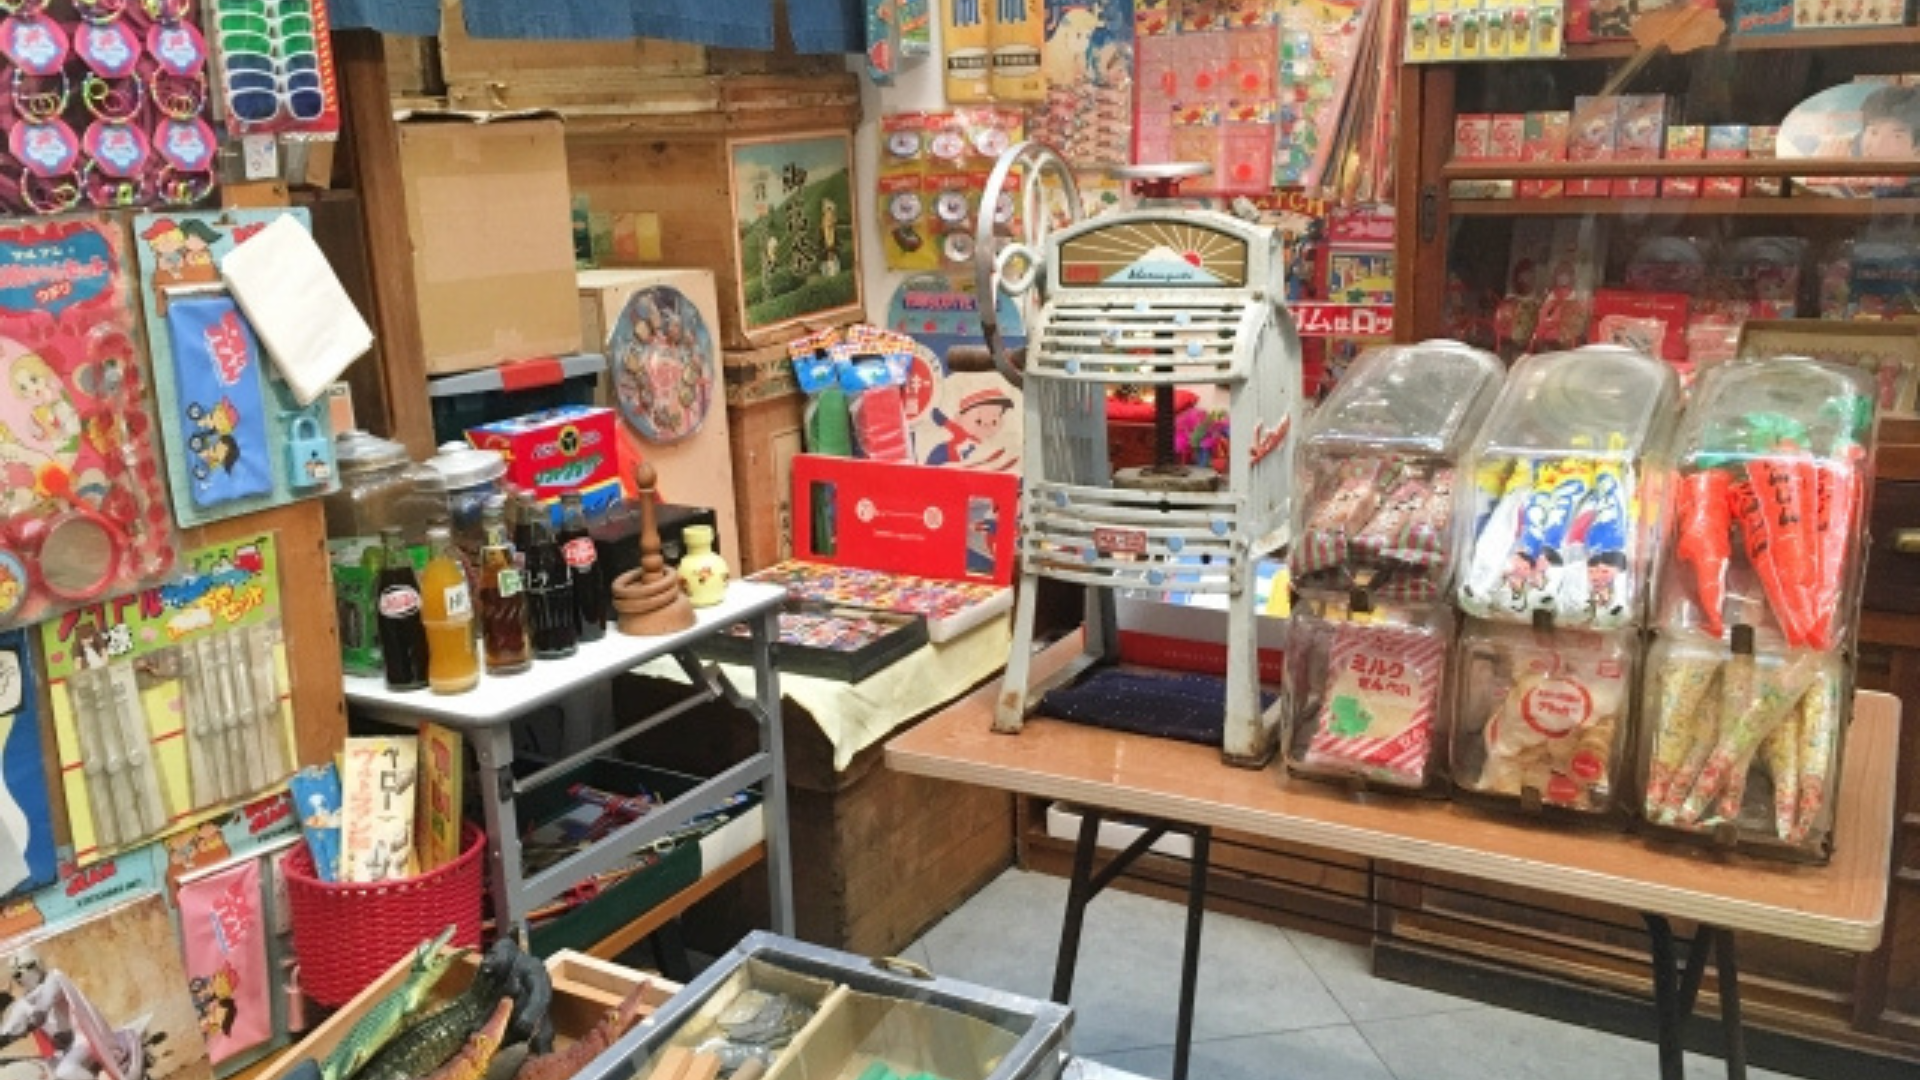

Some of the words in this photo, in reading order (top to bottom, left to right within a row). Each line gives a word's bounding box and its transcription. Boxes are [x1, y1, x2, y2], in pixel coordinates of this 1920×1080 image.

[1350, 653, 1405, 678] ミルク
[1358, 676, 1412, 697] せんべい
